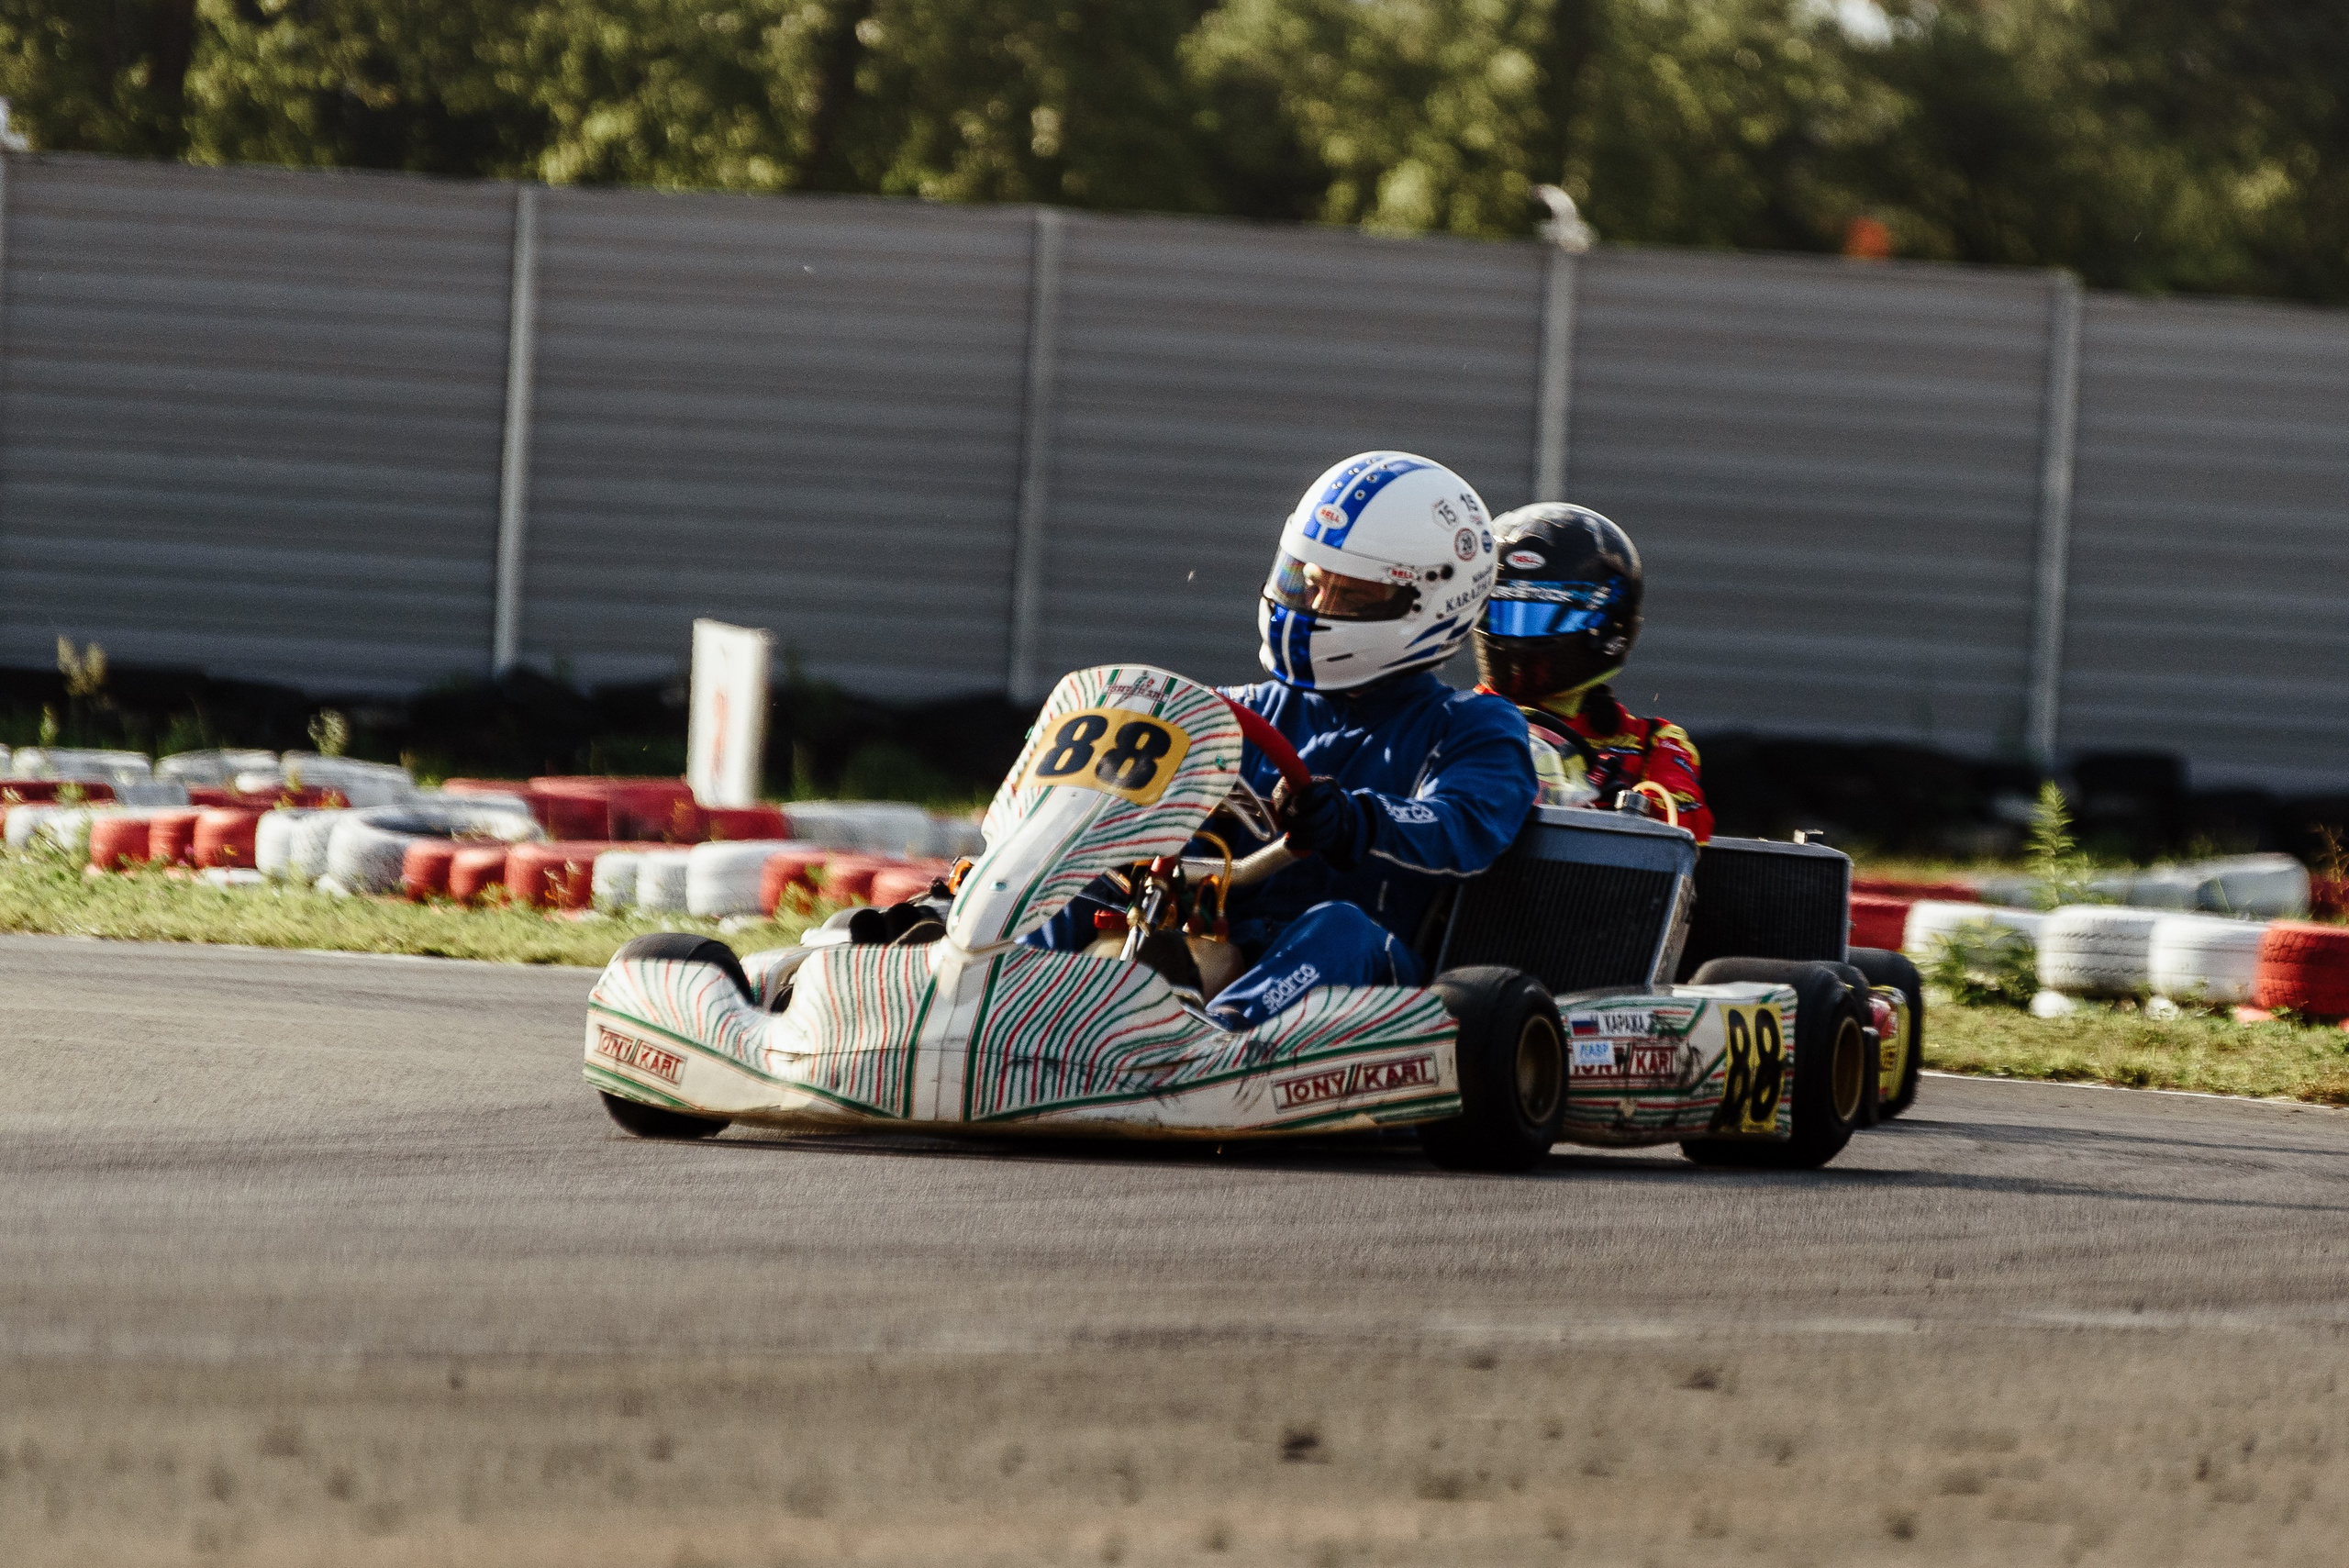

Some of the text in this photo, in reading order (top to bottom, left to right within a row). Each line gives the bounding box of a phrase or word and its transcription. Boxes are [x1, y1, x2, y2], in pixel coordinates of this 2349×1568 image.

[1320, 507, 1341, 524] BELL
[1438, 504, 1457, 526] 15
[1390, 568, 1414, 580] BELL
[1035, 714, 1172, 791] 88
[1262, 963, 1318, 1014] sparco
[638, 1040, 685, 1084] KART
[1277, 1057, 1434, 1108] TONY KART
[1720, 1007, 1782, 1124] 88
